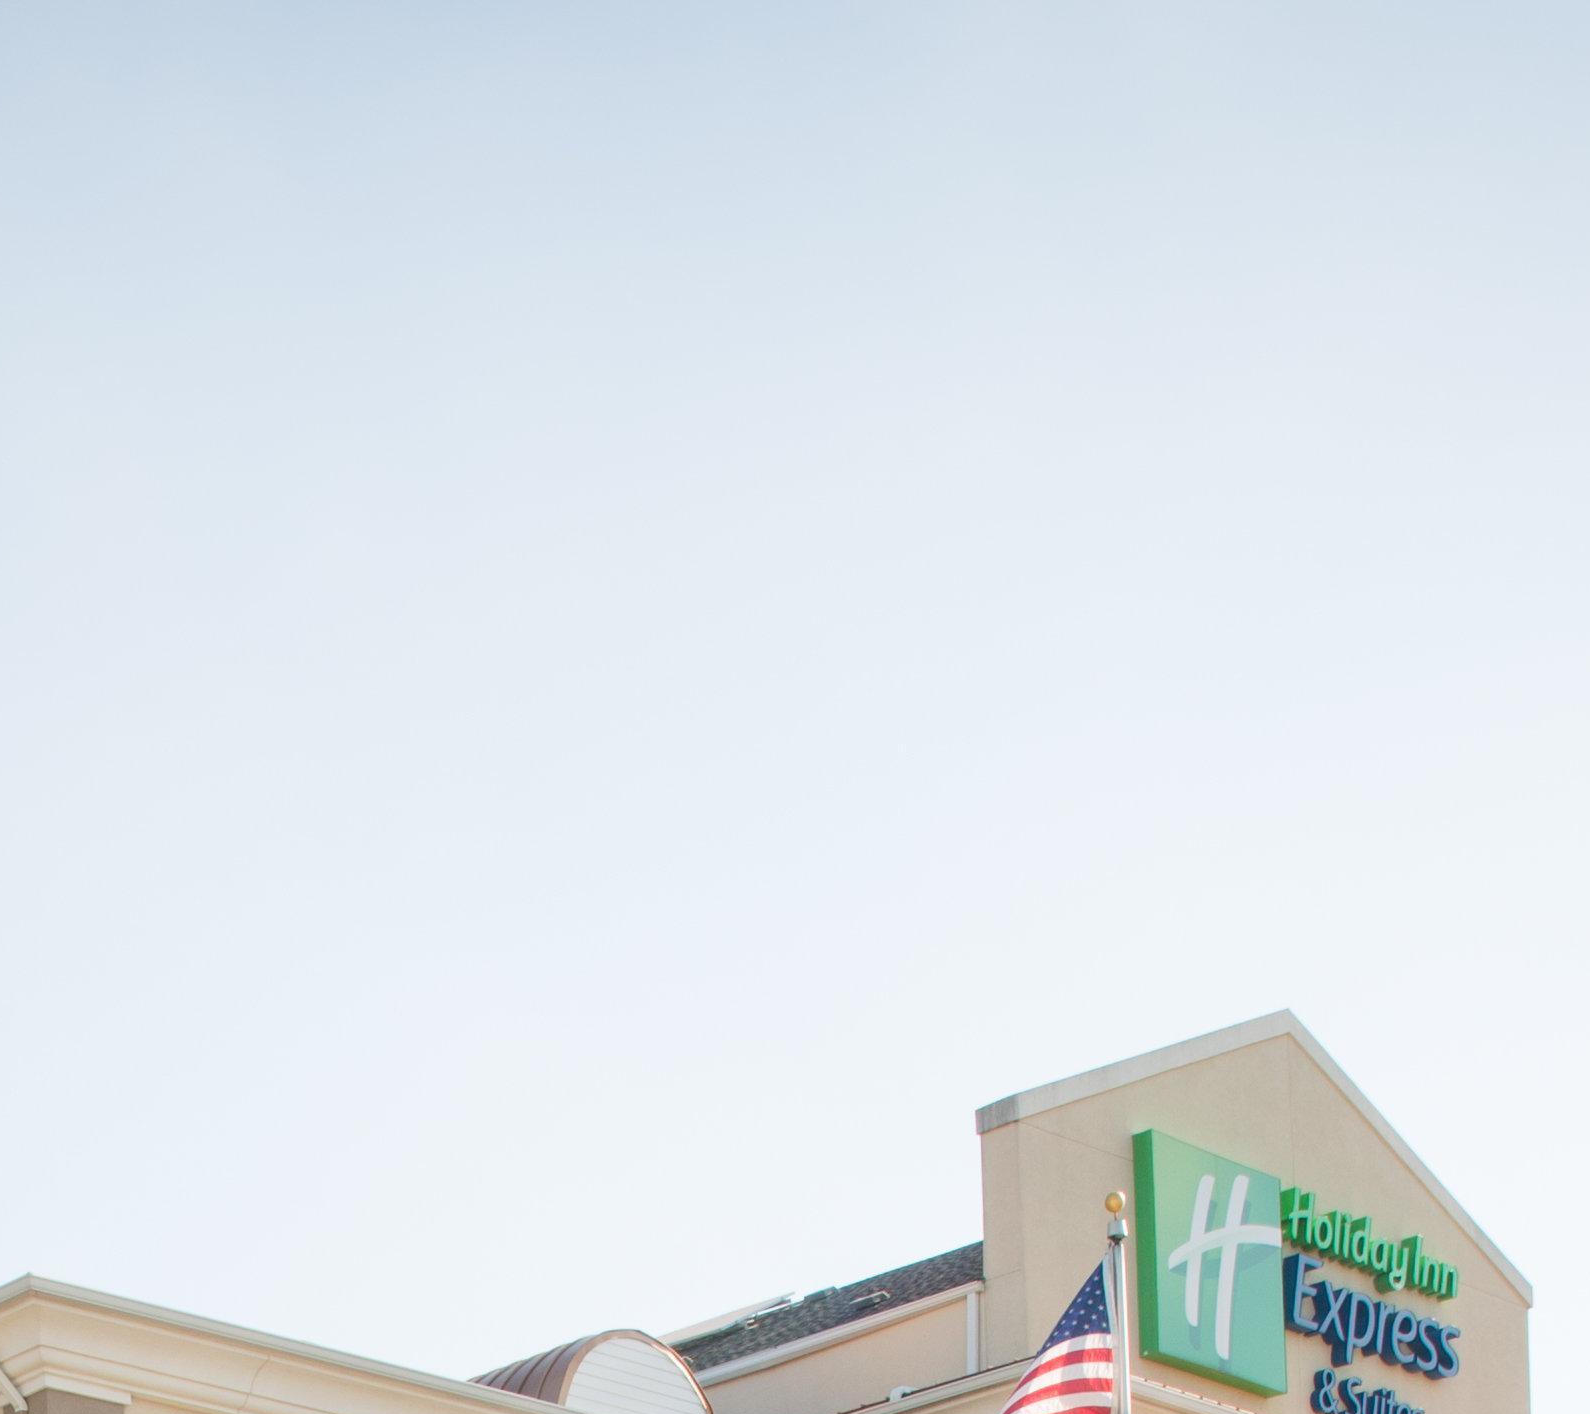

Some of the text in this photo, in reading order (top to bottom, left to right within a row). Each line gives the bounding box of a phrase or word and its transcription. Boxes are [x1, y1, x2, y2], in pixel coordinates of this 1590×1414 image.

[1282, 1187, 1458, 1301] Holiday Inn
[1284, 1253, 1461, 1380] Express
